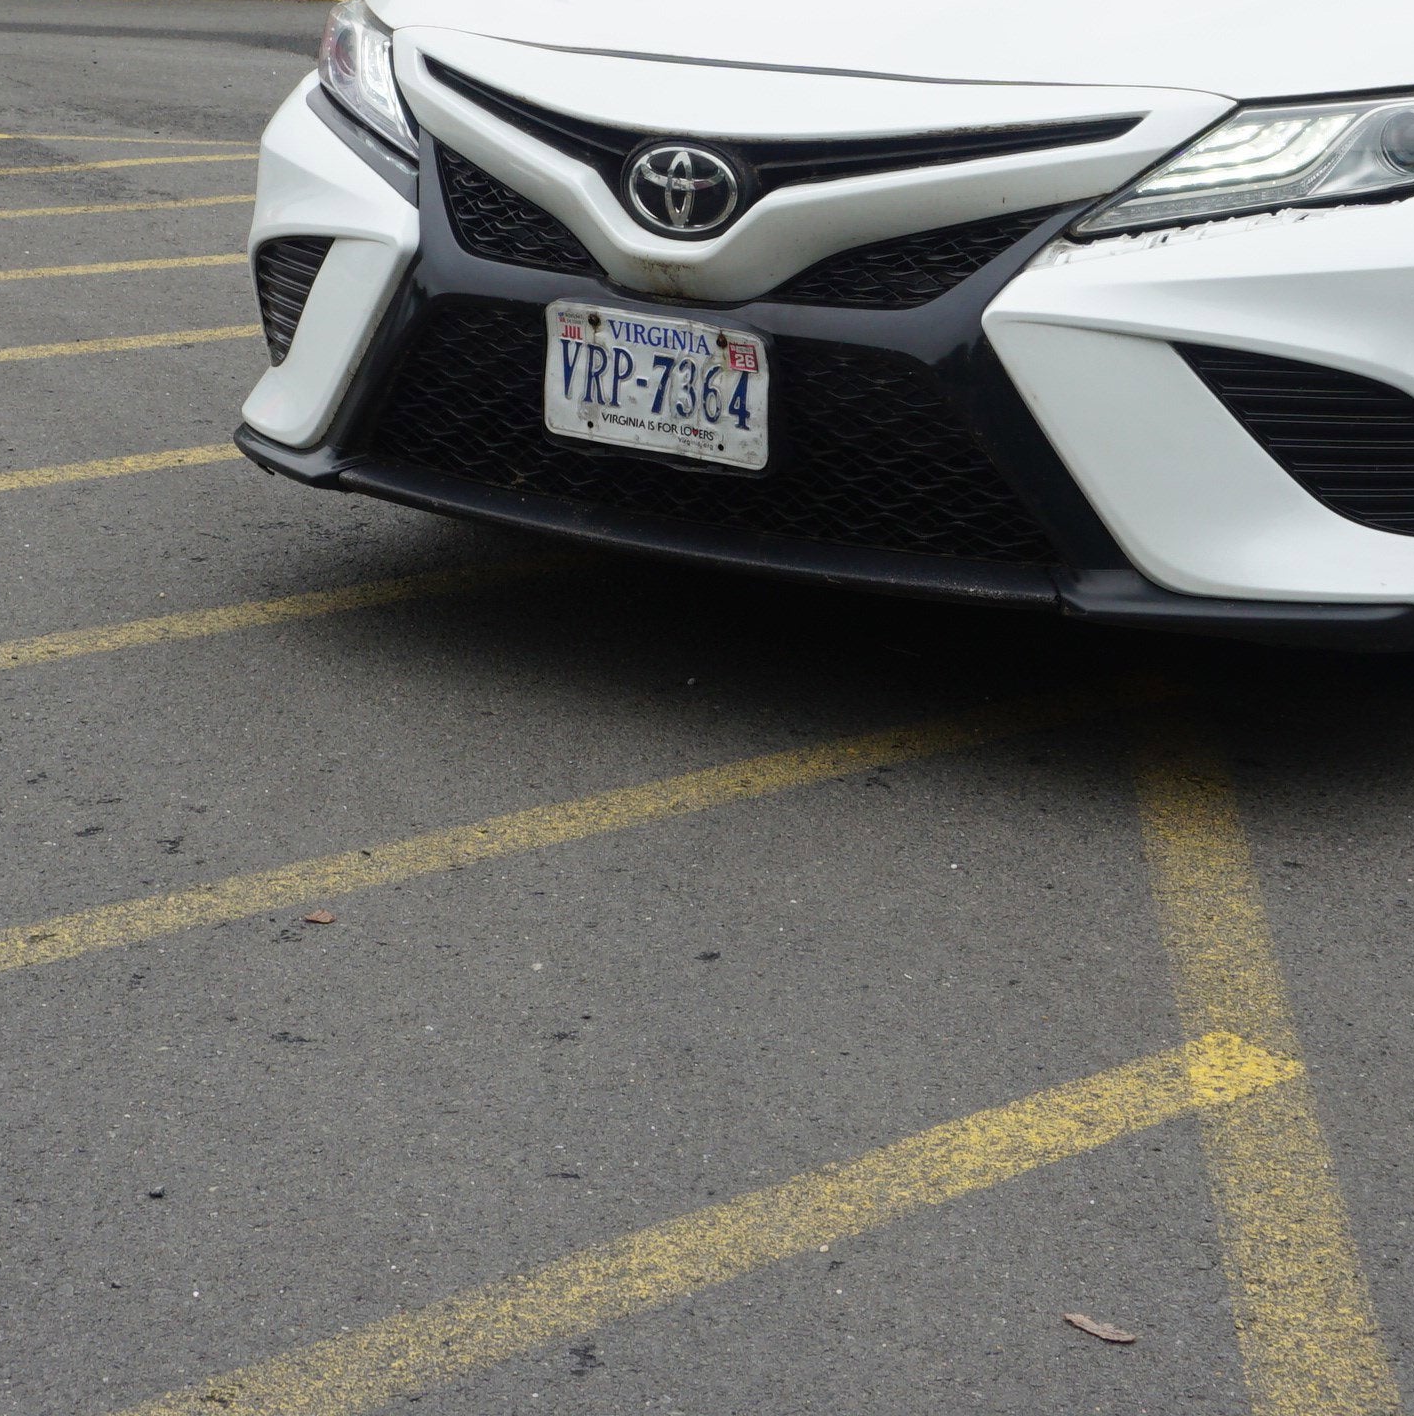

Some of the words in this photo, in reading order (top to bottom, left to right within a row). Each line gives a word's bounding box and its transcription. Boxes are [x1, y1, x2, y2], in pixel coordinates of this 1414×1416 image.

[561, 325, 583, 340] JUL
[607, 319, 711, 356] VIRGINIA
[734, 353, 756, 368] 26
[560, 339, 751, 431] VRP-7364
[601, 412, 646, 430] VIRGINIA
[647, 421, 655, 431] IS
[657, 422, 678, 434] FOR
[680, 426, 714, 441] LOVERS
